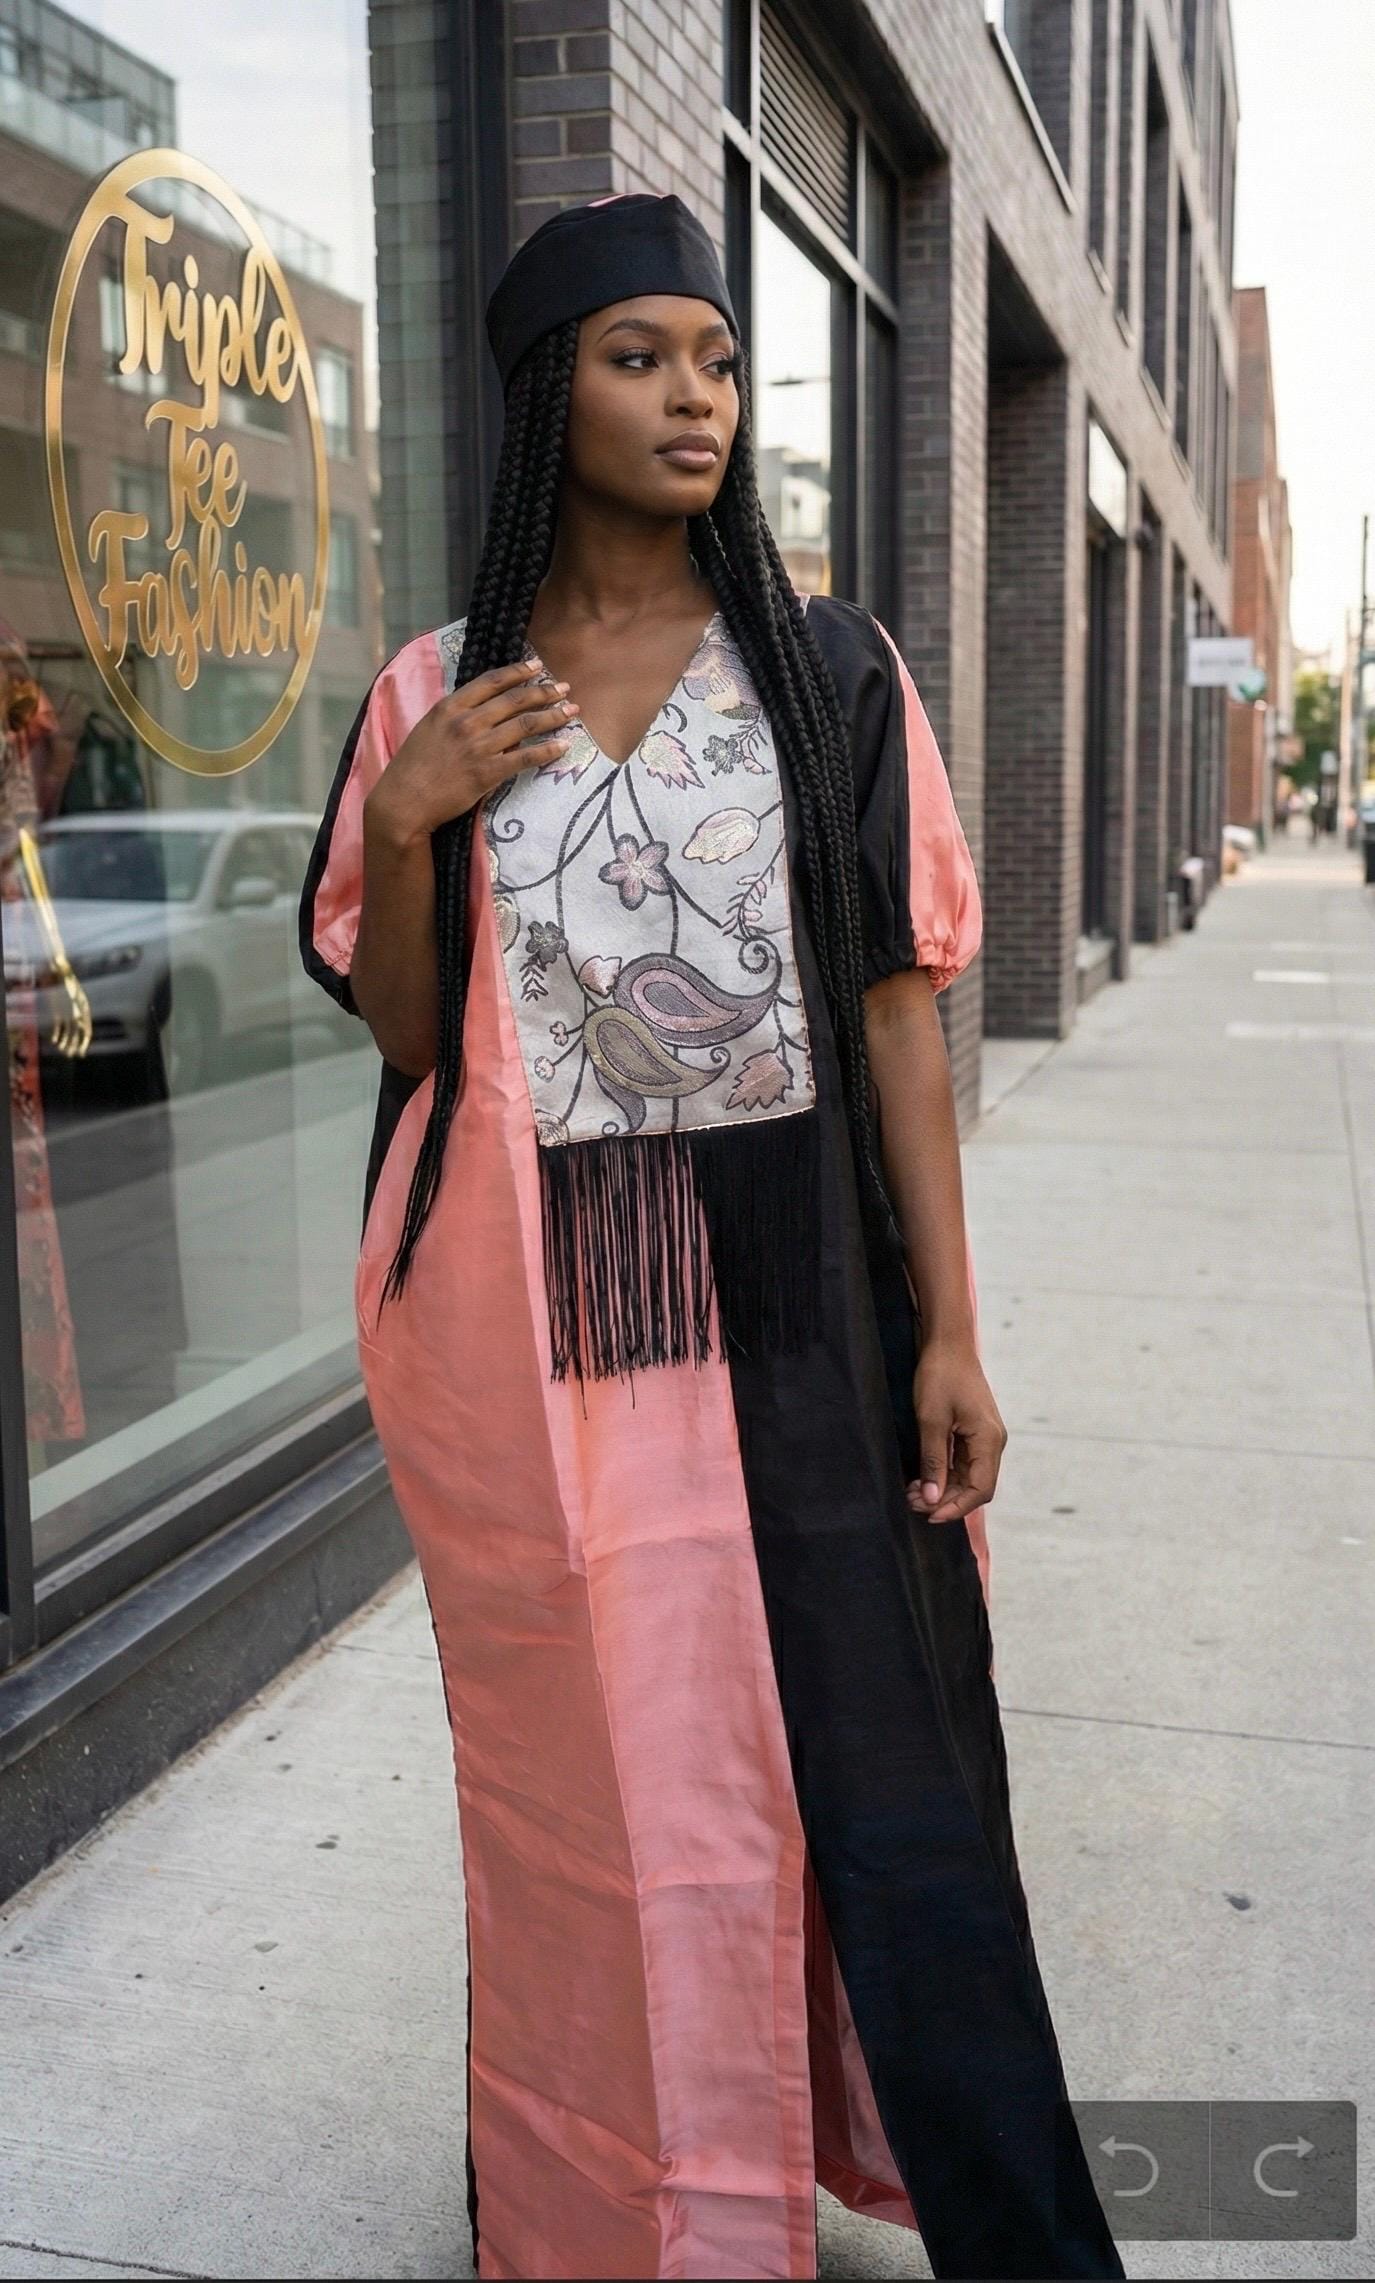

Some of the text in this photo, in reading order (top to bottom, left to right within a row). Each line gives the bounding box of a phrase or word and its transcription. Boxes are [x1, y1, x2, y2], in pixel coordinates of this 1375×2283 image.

[111, 197, 300, 429] Triple
[146, 399, 246, 551] Tee
[88, 510, 311, 691] Fashion
